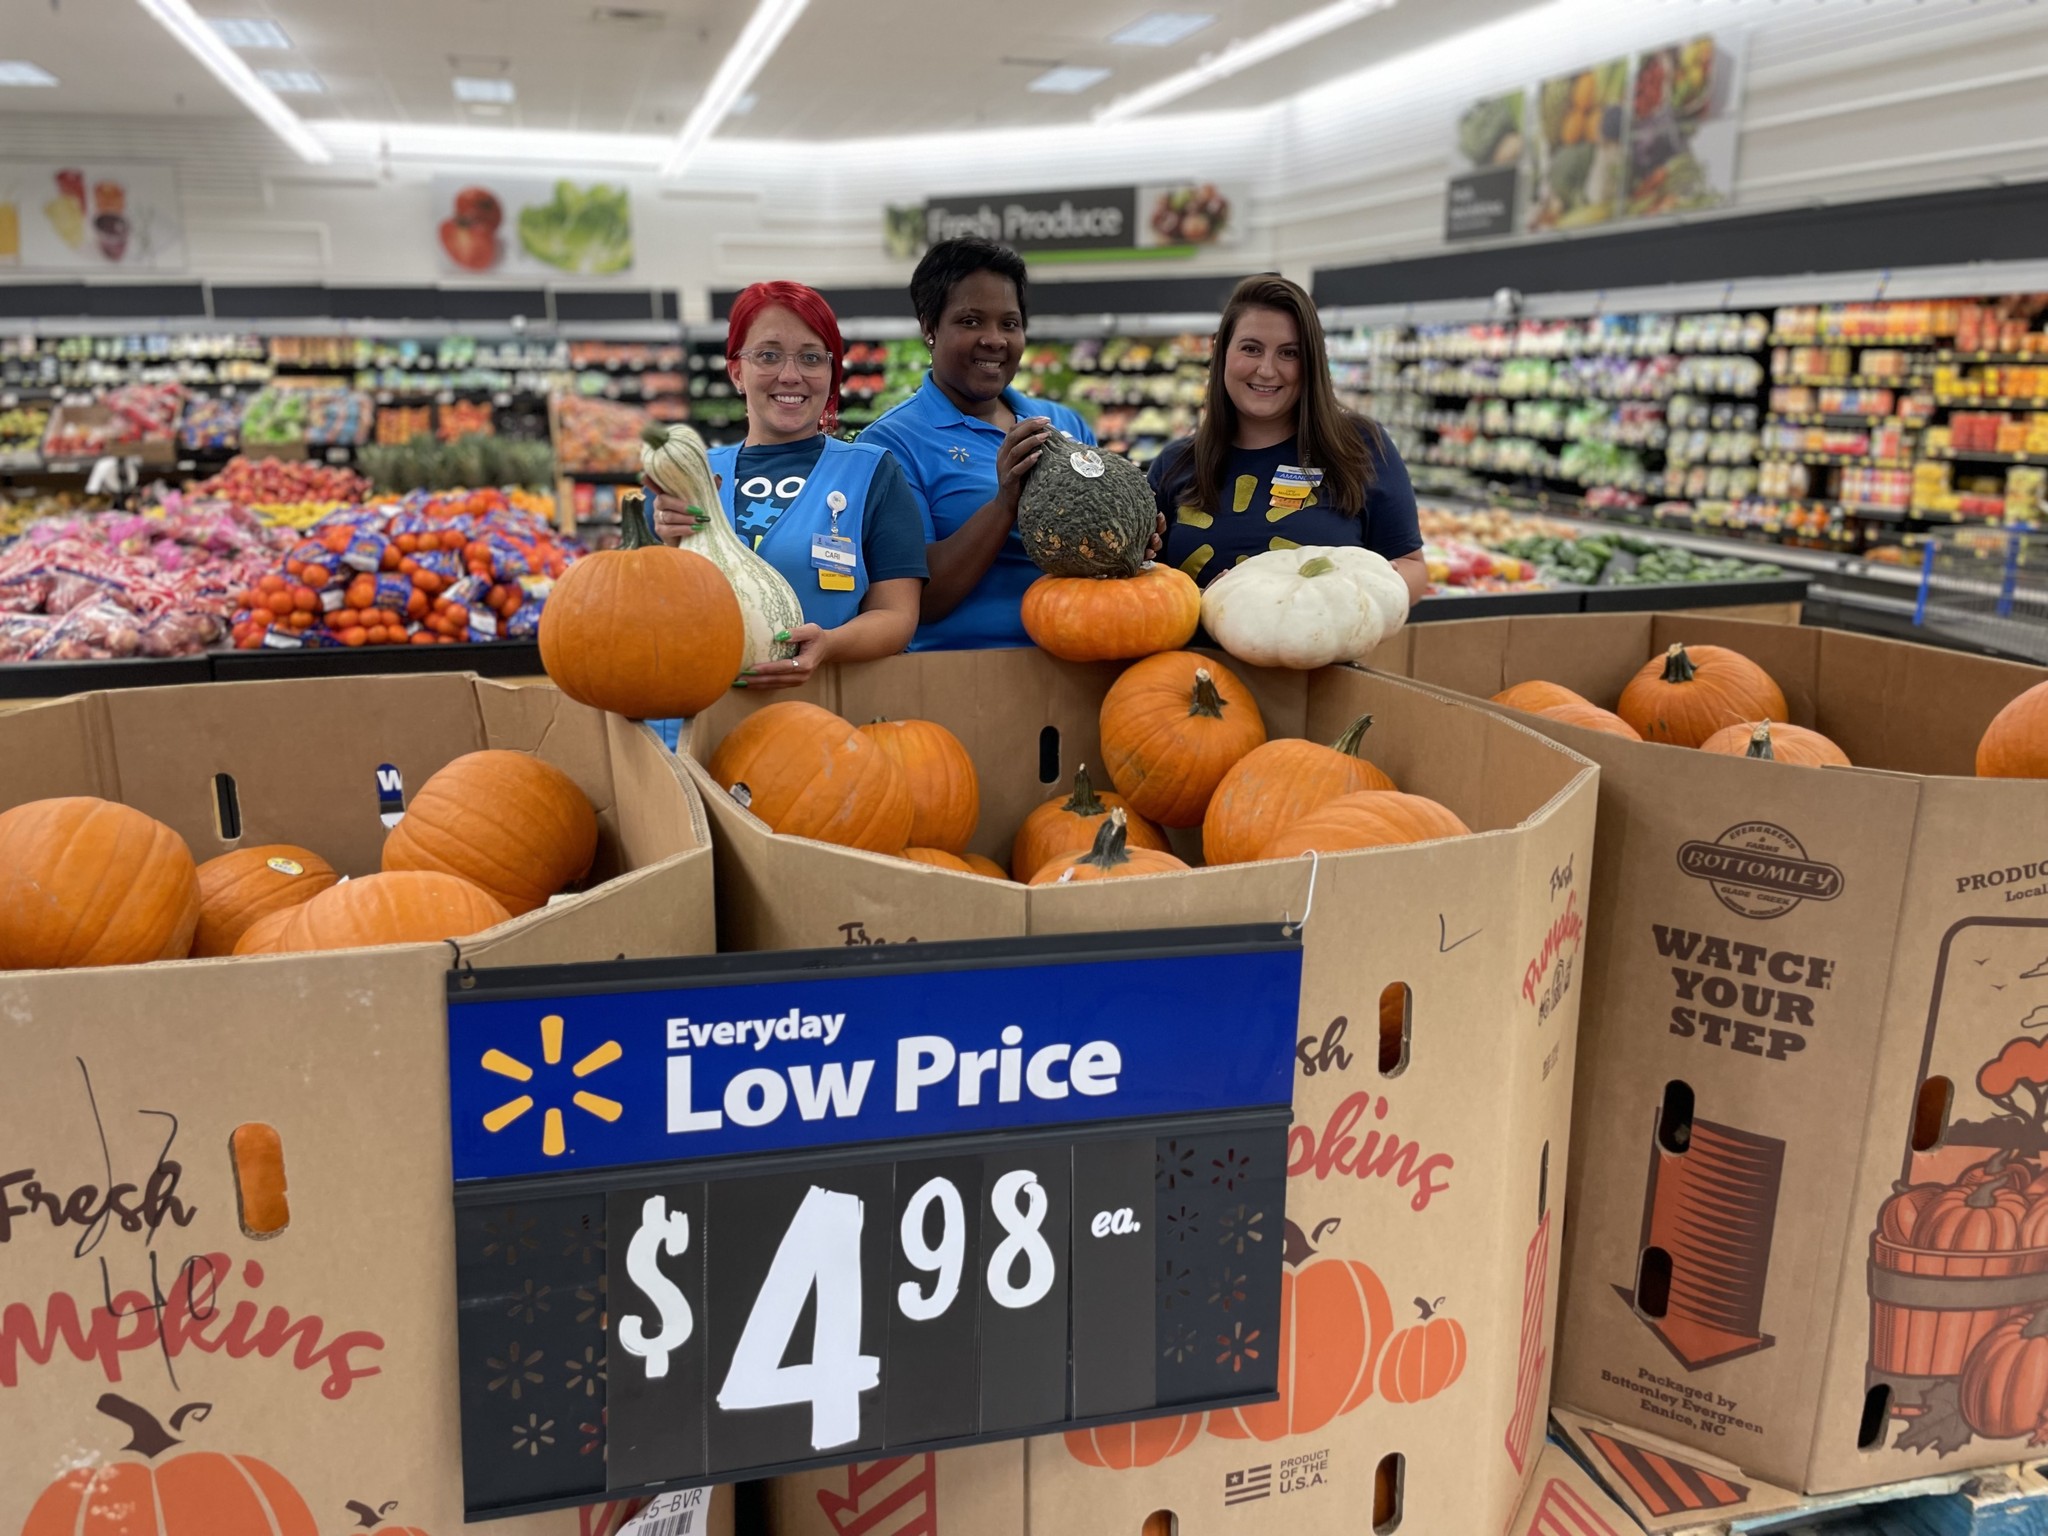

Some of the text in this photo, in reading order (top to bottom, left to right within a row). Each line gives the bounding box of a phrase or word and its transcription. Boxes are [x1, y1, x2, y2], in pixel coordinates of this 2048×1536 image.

[1003, 201, 1123, 241] Produce
[824, 550, 841, 560] CARI
[1687, 850, 1834, 890] BOTTOMLEY
[1720, 886, 1790, 906] GLADE CREEK
[1671, 966, 1815, 1027] YOUR
[667, 1008, 846, 1051] Everyday
[1669, 1006, 1806, 1061] STEP
[667, 1025, 1121, 1134] Low Price
[0, 1160, 198, 1243] Fresh
[1090, 1207, 1142, 1238] ea.
[1601, 1369, 1764, 1435] Bottomley Evergreen
[1638, 1367, 1737, 1412] Packaged by
[1700, 1420, 1726, 1437] NC
[1279, 1459, 1328, 1480] OF THE
[1280, 1448, 1330, 1470] PRODUCT
[1279, 1473, 1328, 1494] U.S.A.
[628, 1488, 703, 1527] 5-BVR
